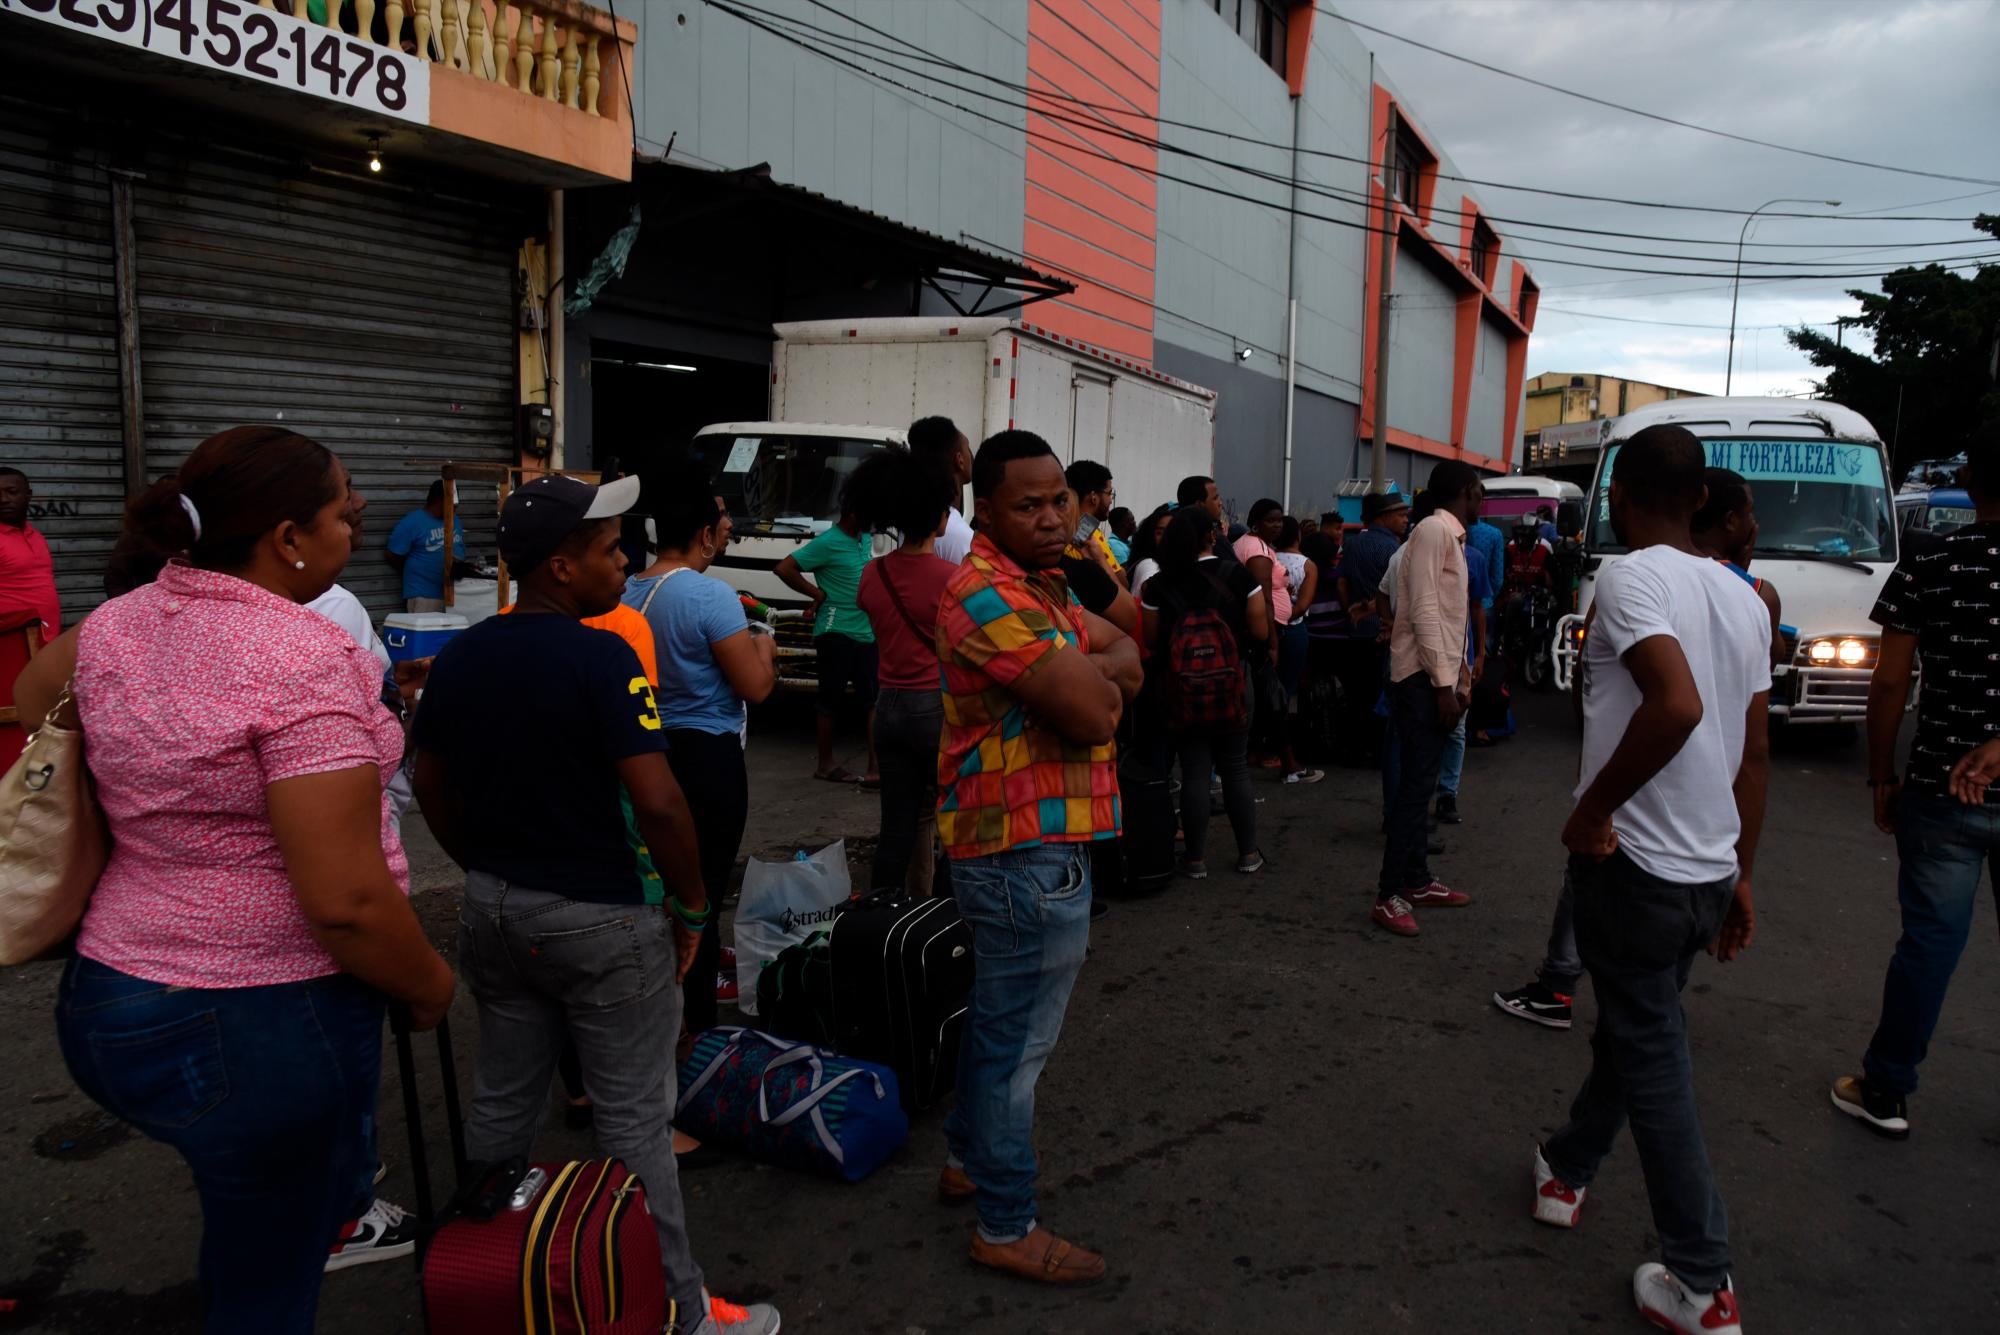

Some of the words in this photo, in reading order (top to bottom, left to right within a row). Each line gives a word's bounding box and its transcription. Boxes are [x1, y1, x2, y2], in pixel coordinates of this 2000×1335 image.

[1711, 443, 1731, 469] MI
[1738, 443, 1836, 475] FORTALEZA
[628, 676, 661, 731] 3
